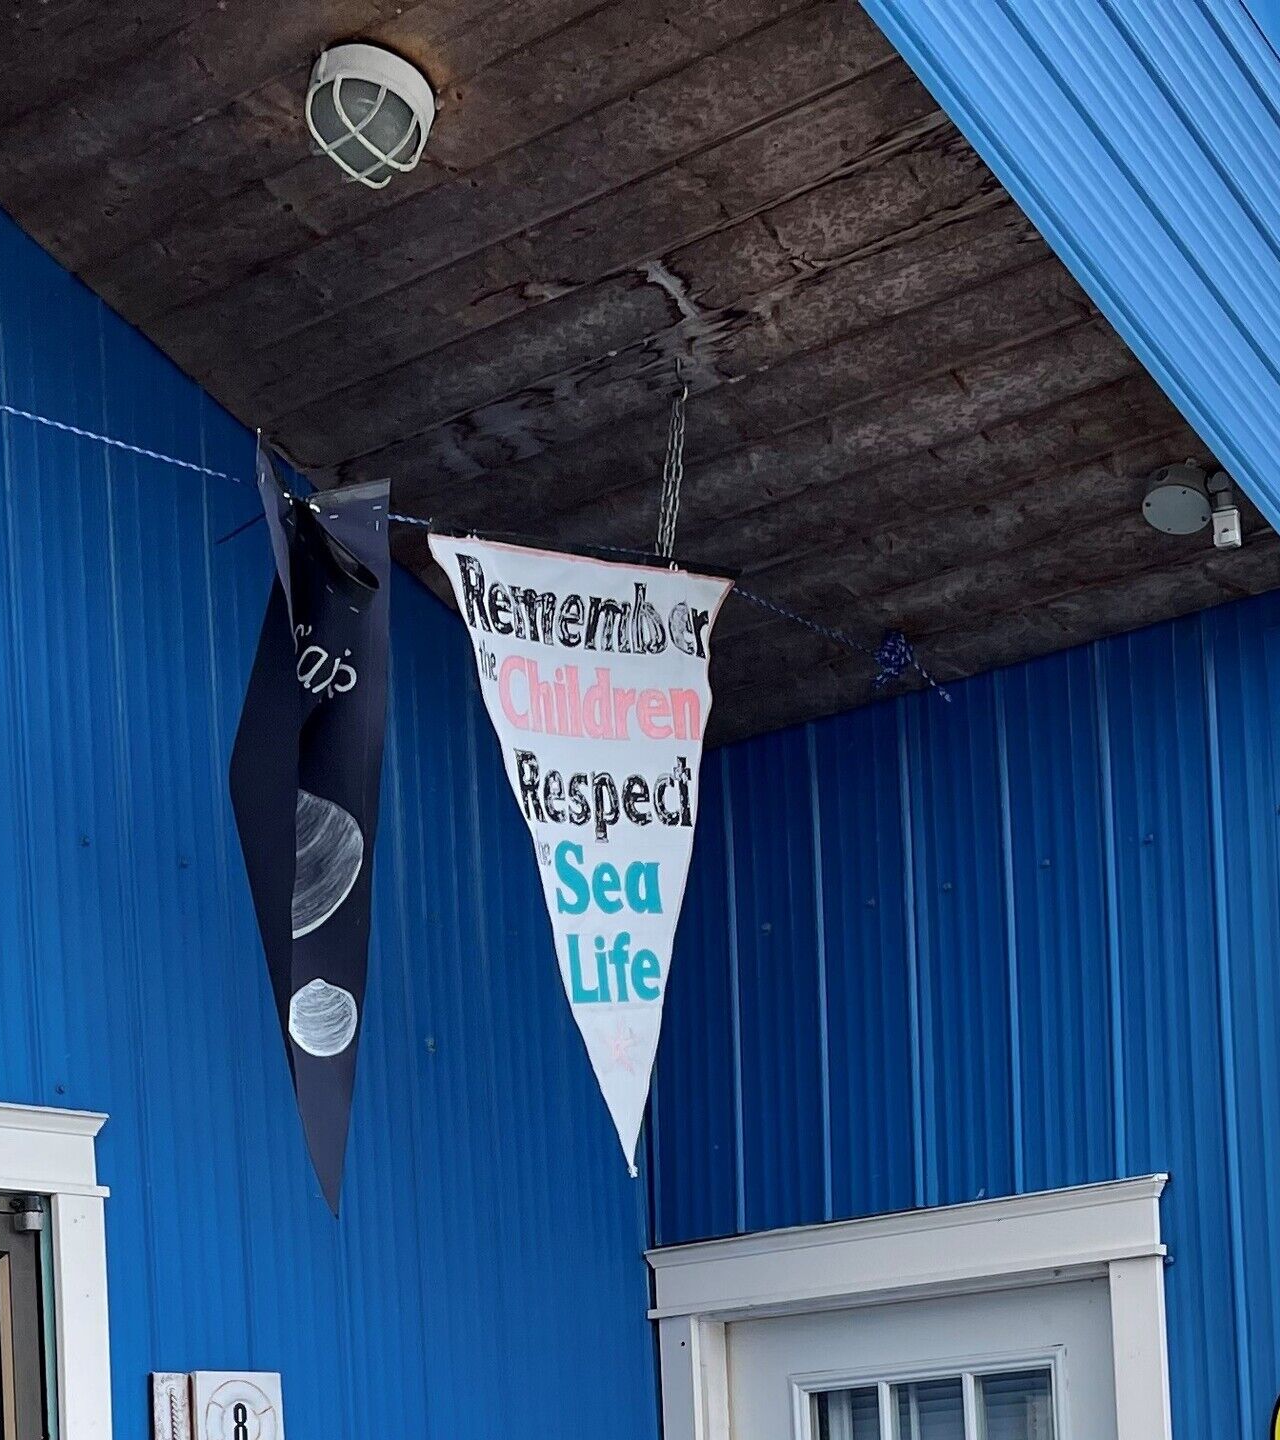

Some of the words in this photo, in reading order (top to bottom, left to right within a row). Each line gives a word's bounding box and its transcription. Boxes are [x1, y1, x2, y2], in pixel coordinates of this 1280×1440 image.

[455, 552, 709, 659] Remember
[479, 640, 498, 682] the
[498, 655, 701, 741] Children
[514, 748, 693, 843] Respect
[554, 840, 663, 915] Sea
[567, 931, 661, 1003] Life
